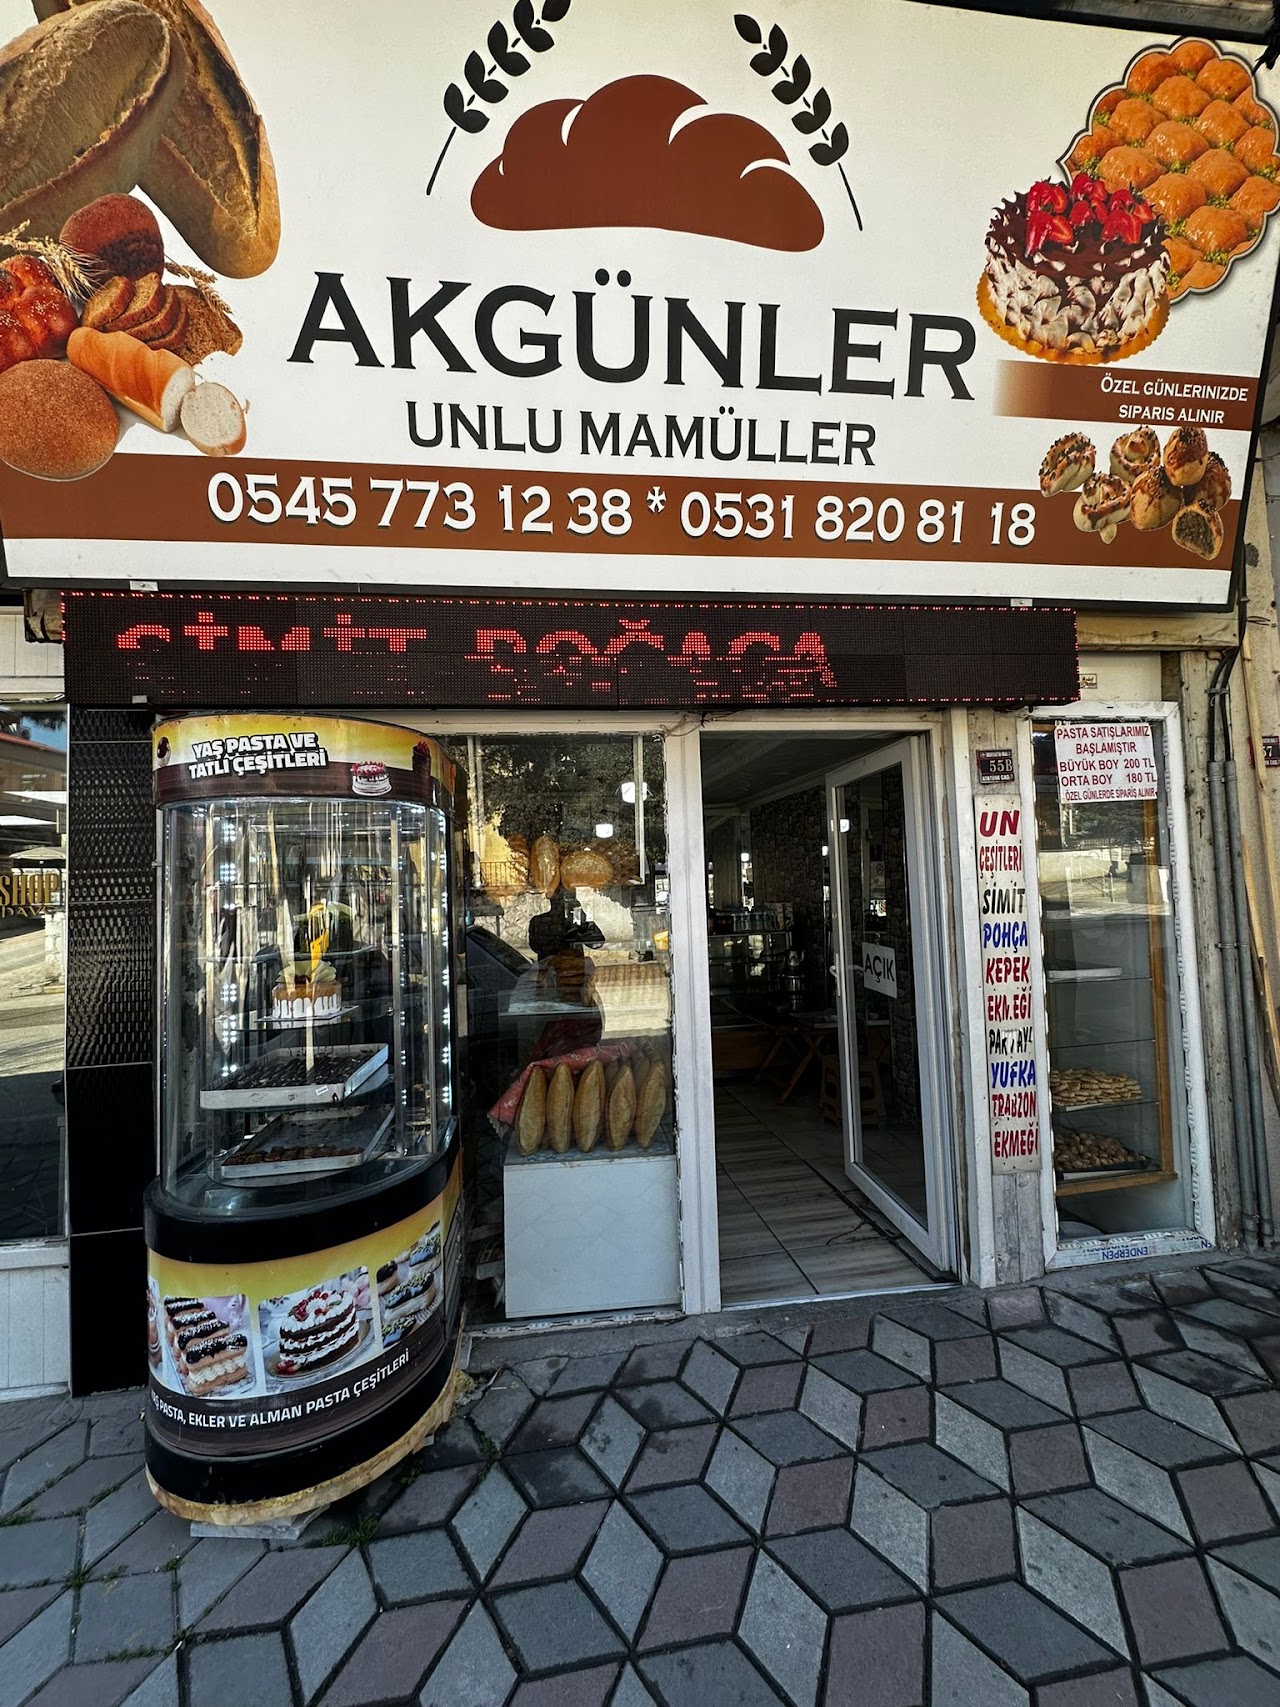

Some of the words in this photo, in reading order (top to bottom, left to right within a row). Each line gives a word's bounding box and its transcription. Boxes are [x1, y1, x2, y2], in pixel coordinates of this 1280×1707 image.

[287, 269, 976, 401] AKGÜNLER
[1101, 372, 1140, 395] ÖZEL
[1143, 379, 1249, 402] GÜNLERINIZDE
[1119, 404, 1175, 421] SIPARIS
[1177, 407, 1225, 424] ALINIR
[407, 400, 563, 454] UNLU
[580, 407, 877, 467] MAMÜLLER
[207, 471, 358, 528] 0545
[369, 477, 477, 532] 773
[498, 484, 554, 535] 12
[566, 487, 634, 538] 38
[681, 491, 795, 543] 0531
[815, 494, 905, 545] 820
[916, 498, 965, 546] 81
[990, 502, 1038, 549] 18
[193, 740, 224, 760] YAŞ
[226, 734, 288, 754] PASTA
[289, 733, 317, 748] VE
[1056, 727, 1089, 740] PASTA
[1090, 725, 1150, 741] SATIŞLARIMIZ
[188, 759, 230, 779] TATLI
[232, 748, 327, 777] ÇEŞİTLERİ
[1076, 741, 1137, 756] BAŞLAMIŞTIR
[989, 758, 1013, 772] 55B
[1059, 758, 1097, 772] BÜYÜK
[1098, 759, 1119, 771] BOY
[1123, 758, 1140, 769] 200
[1142, 757, 1155, 768] TL
[1061, 775, 1090, 787] ORTA
[1092, 774, 1113, 785] BOY
[1126, 773, 1143, 784] 180
[1145, 772, 1157, 783] TL
[1065, 789, 1082, 801] ÖZEL
[1082, 788, 1115, 800] GÜNLERDE
[1115, 786, 1138, 799] SİPARİŞ
[980, 809, 1020, 837] UN
[979, 839, 1022, 879] ÇEŞİTLERİ
[982, 881, 1026, 915] SİMİT
[983, 920, 1028, 954] POHÇA
[864, 952, 896, 983] AÇIK
[986, 956, 1031, 986] KEPEK
[991, 1059, 1037, 1089] YUFKA
[991, 1091, 1037, 1119] TRABZON
[994, 1121, 1039, 1160] EKMEĞİ
[160, 1398, 187, 1425] PASTA,
[188, 1412, 226, 1428] EKLER
[228, 1415, 247, 1428] VE
[250, 1404, 302, 1427] ALMAN
[306, 1387, 350, 1414] PASTA
[353, 1347, 410, 1397] ÇEŞİTLERİ
